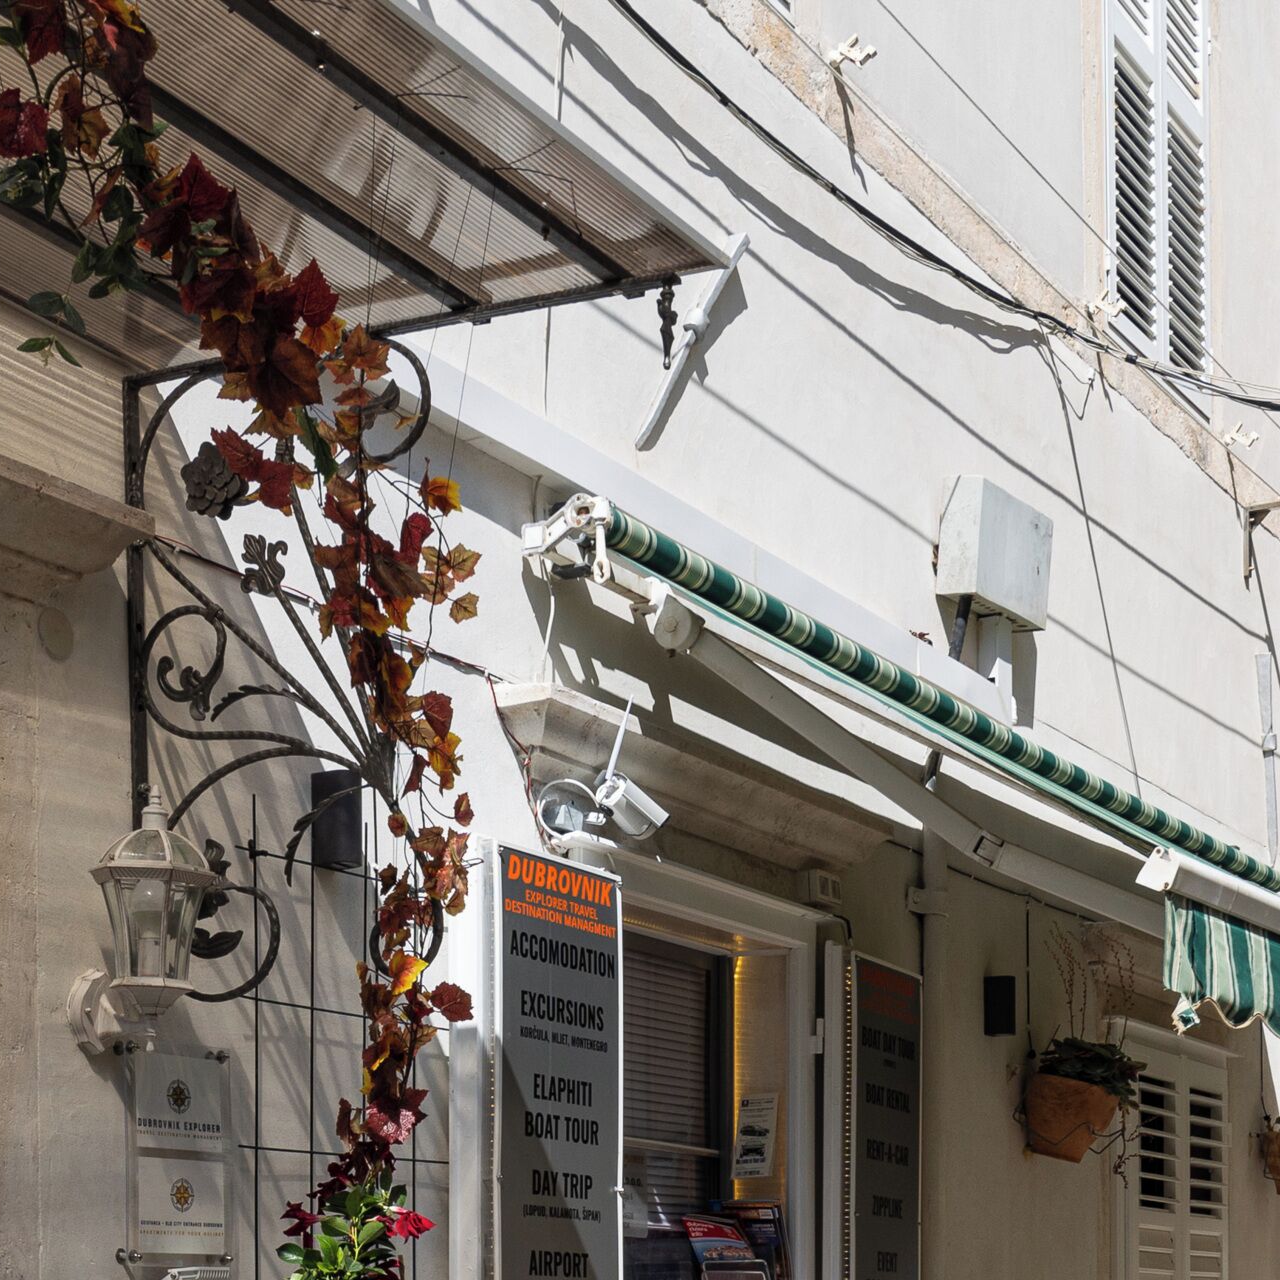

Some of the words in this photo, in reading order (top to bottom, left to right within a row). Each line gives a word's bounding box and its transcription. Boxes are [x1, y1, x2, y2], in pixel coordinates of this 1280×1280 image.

[507, 854, 613, 907] DUBROVNIK
[505, 898, 563, 925] DESTINATION
[564, 912, 616, 938] MANAGMENT
[525, 889, 568, 912] EXPLORER
[569, 901, 598, 920] TRAVEL
[510, 929, 615, 979] ACCOMODATION
[520, 990, 604, 1031] EXCURSIONS
[571, 1035, 608, 1053] MONTENEGRO
[862, 1025, 881, 1050] BOAT
[882, 1032, 897, 1055] DAY
[898, 1037, 915, 1061] TOUR
[533, 1073, 592, 1107] ELAPHITI
[865, 1083, 885, 1107] BOAT
[886, 1088, 911, 1113] RENTAL
[137, 1117, 180, 1130] DUBROVNIK
[184, 1121, 221, 1134] EXPLORER
[524, 1110, 561, 1140] BOAT
[563, 1116, 599, 1146] TOUR
[866, 1138, 908, 1166] RENT-A-CAR
[532, 1169, 559, 1197] DAY
[562, 1172, 593, 1200] TRIP
[872, 1194, 903, 1219] ZIPPLINE
[529, 1250, 588, 1278] AIRPORT
[877, 1251, 897, 1272] EVENT
